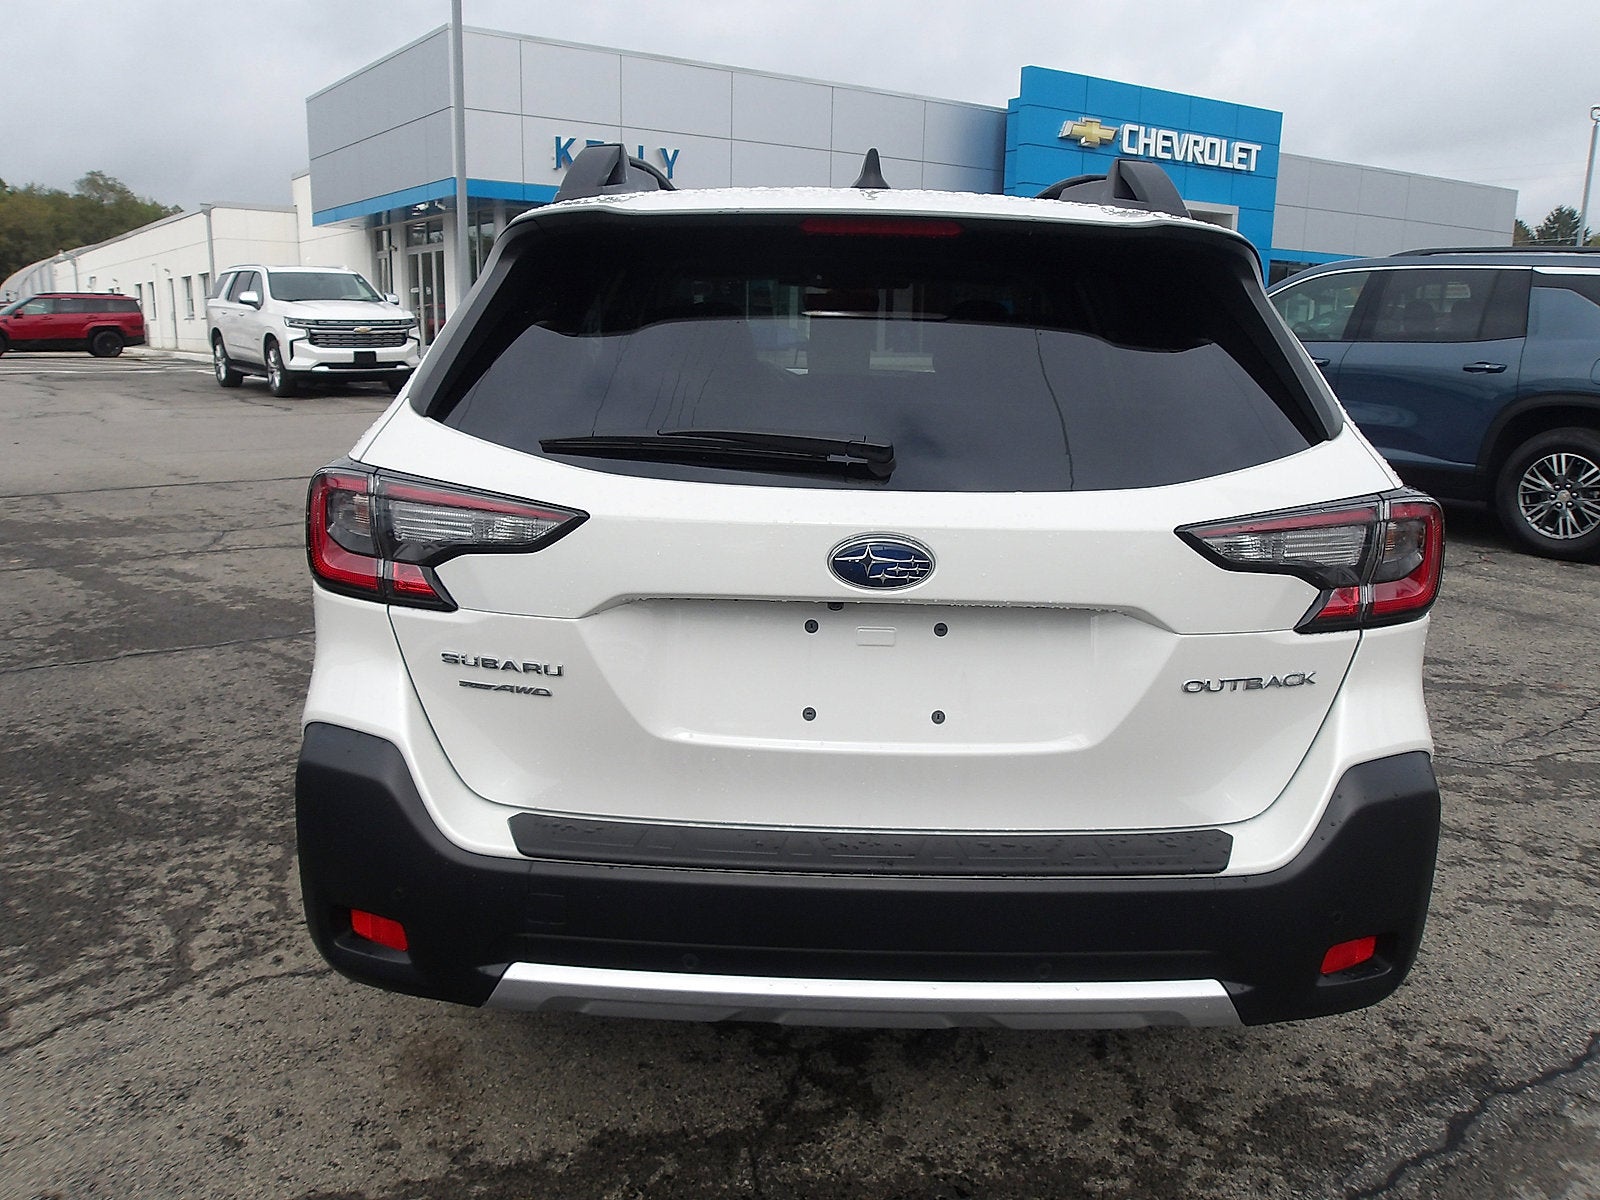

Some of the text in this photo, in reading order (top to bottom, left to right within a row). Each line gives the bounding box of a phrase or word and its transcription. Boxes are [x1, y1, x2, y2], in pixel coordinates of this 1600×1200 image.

[1120, 123, 1262, 171] CHEVROLET
[441, 651, 564, 677] SUBARU
[494, 684, 553, 697] AWD
[1181, 671, 1317, 693] OUTBACK
